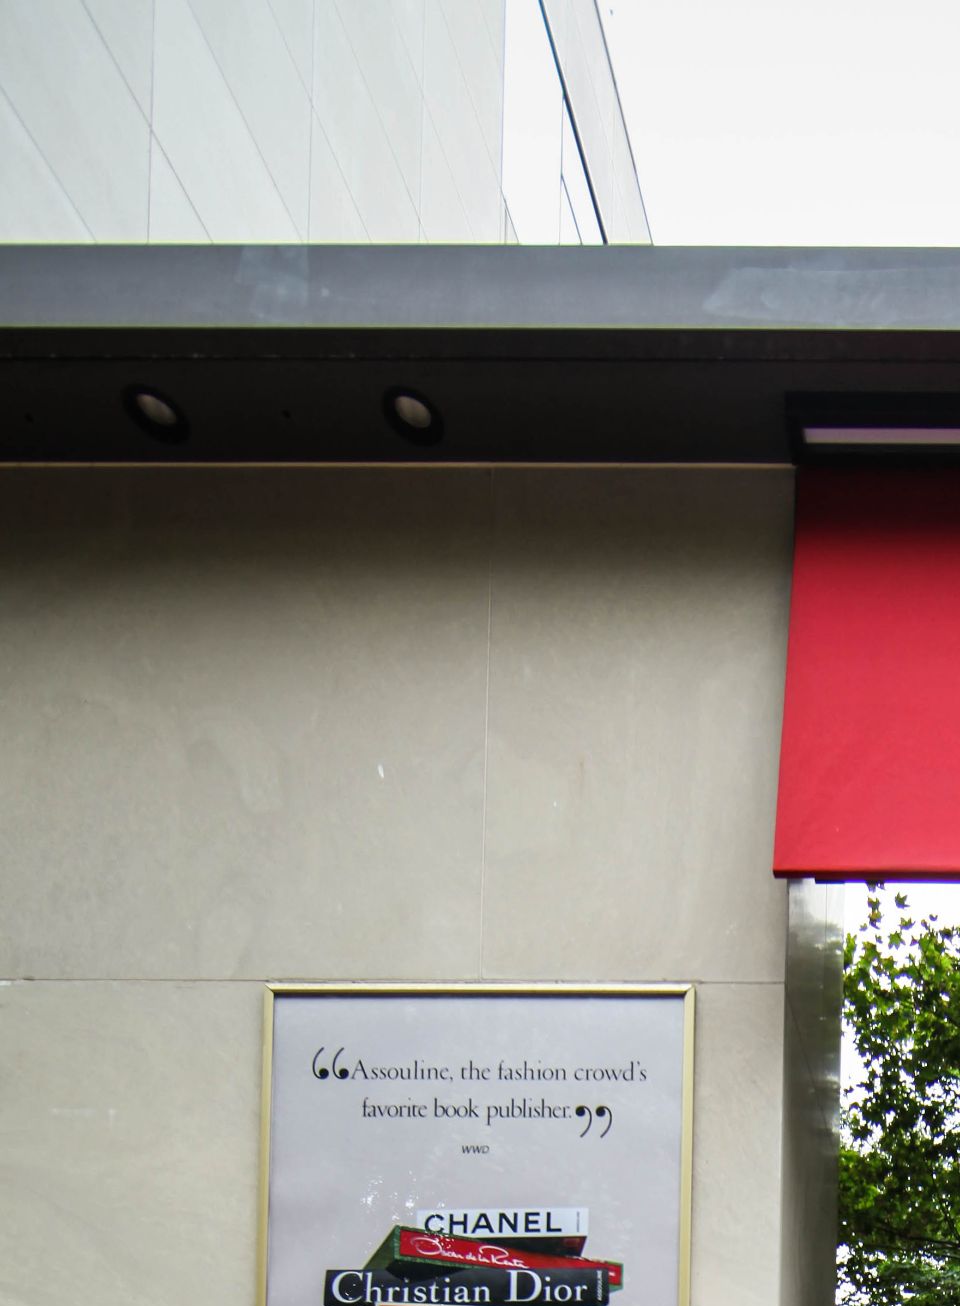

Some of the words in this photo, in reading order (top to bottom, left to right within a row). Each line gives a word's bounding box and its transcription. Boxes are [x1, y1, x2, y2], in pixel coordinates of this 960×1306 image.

[461, 1058, 491, 1082] the
[498, 1057, 567, 1082] fashion
[362, 1097, 427, 1119] favorite
[434, 1098, 479, 1119] book
[461, 1145, 489, 1155] WWD
[424, 1211, 562, 1235] CHANEL
[332, 1271, 490, 1304] Christian
[506, 1270, 588, 1303] Dior
